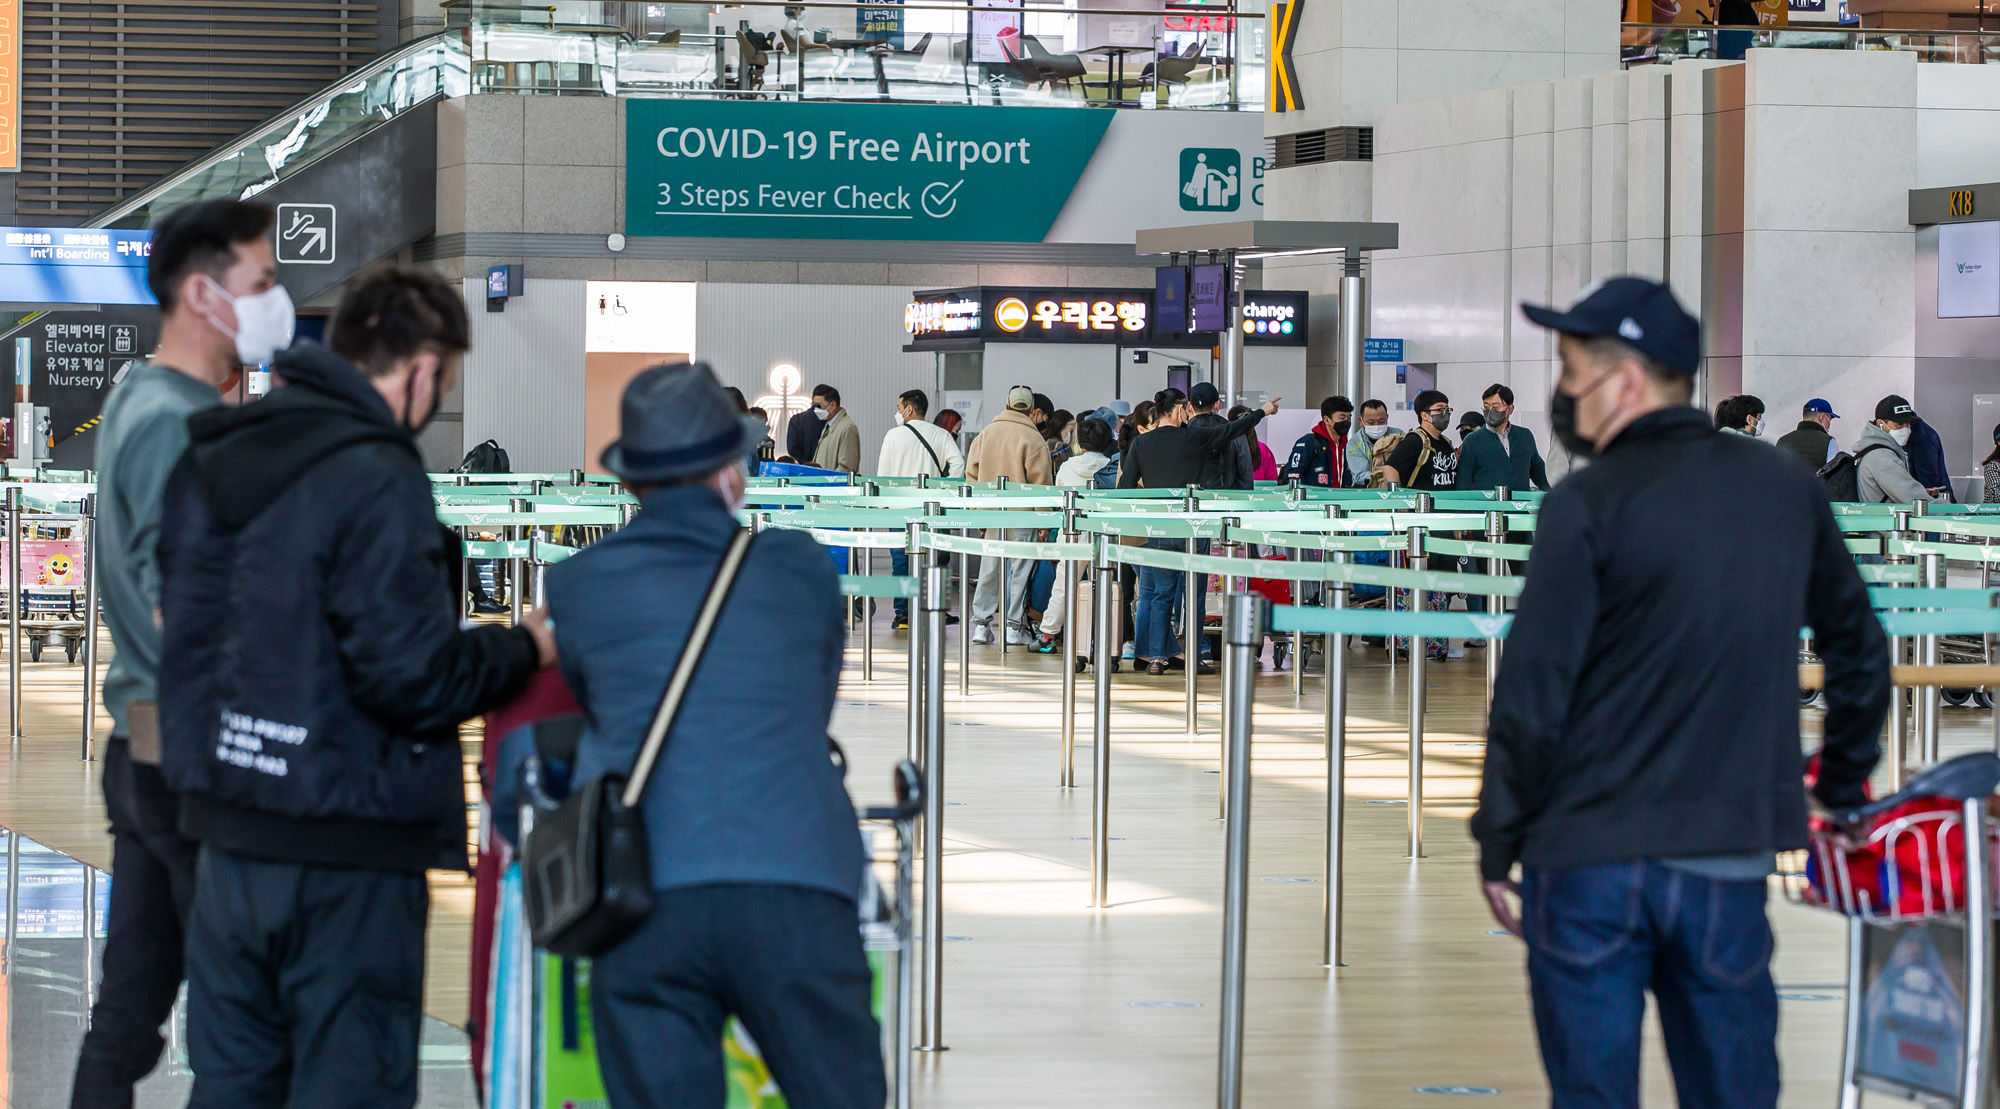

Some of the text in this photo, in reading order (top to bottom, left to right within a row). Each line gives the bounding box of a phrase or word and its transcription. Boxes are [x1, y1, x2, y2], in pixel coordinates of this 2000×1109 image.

[656, 126, 1031, 171] COVID-19 Free Airport
[657, 182, 911, 213] 3 Steps Fever Check
[1949, 190, 1973, 216] K18
[56, 248, 110, 262] Boarding
[1031, 300, 1146, 331] 우리은행
[45, 324, 106, 339] 엘리베이터
[45, 340, 105, 353] Elevator
[46, 357, 105, 371] 유아휴게실
[49, 373, 104, 389] Nursery
